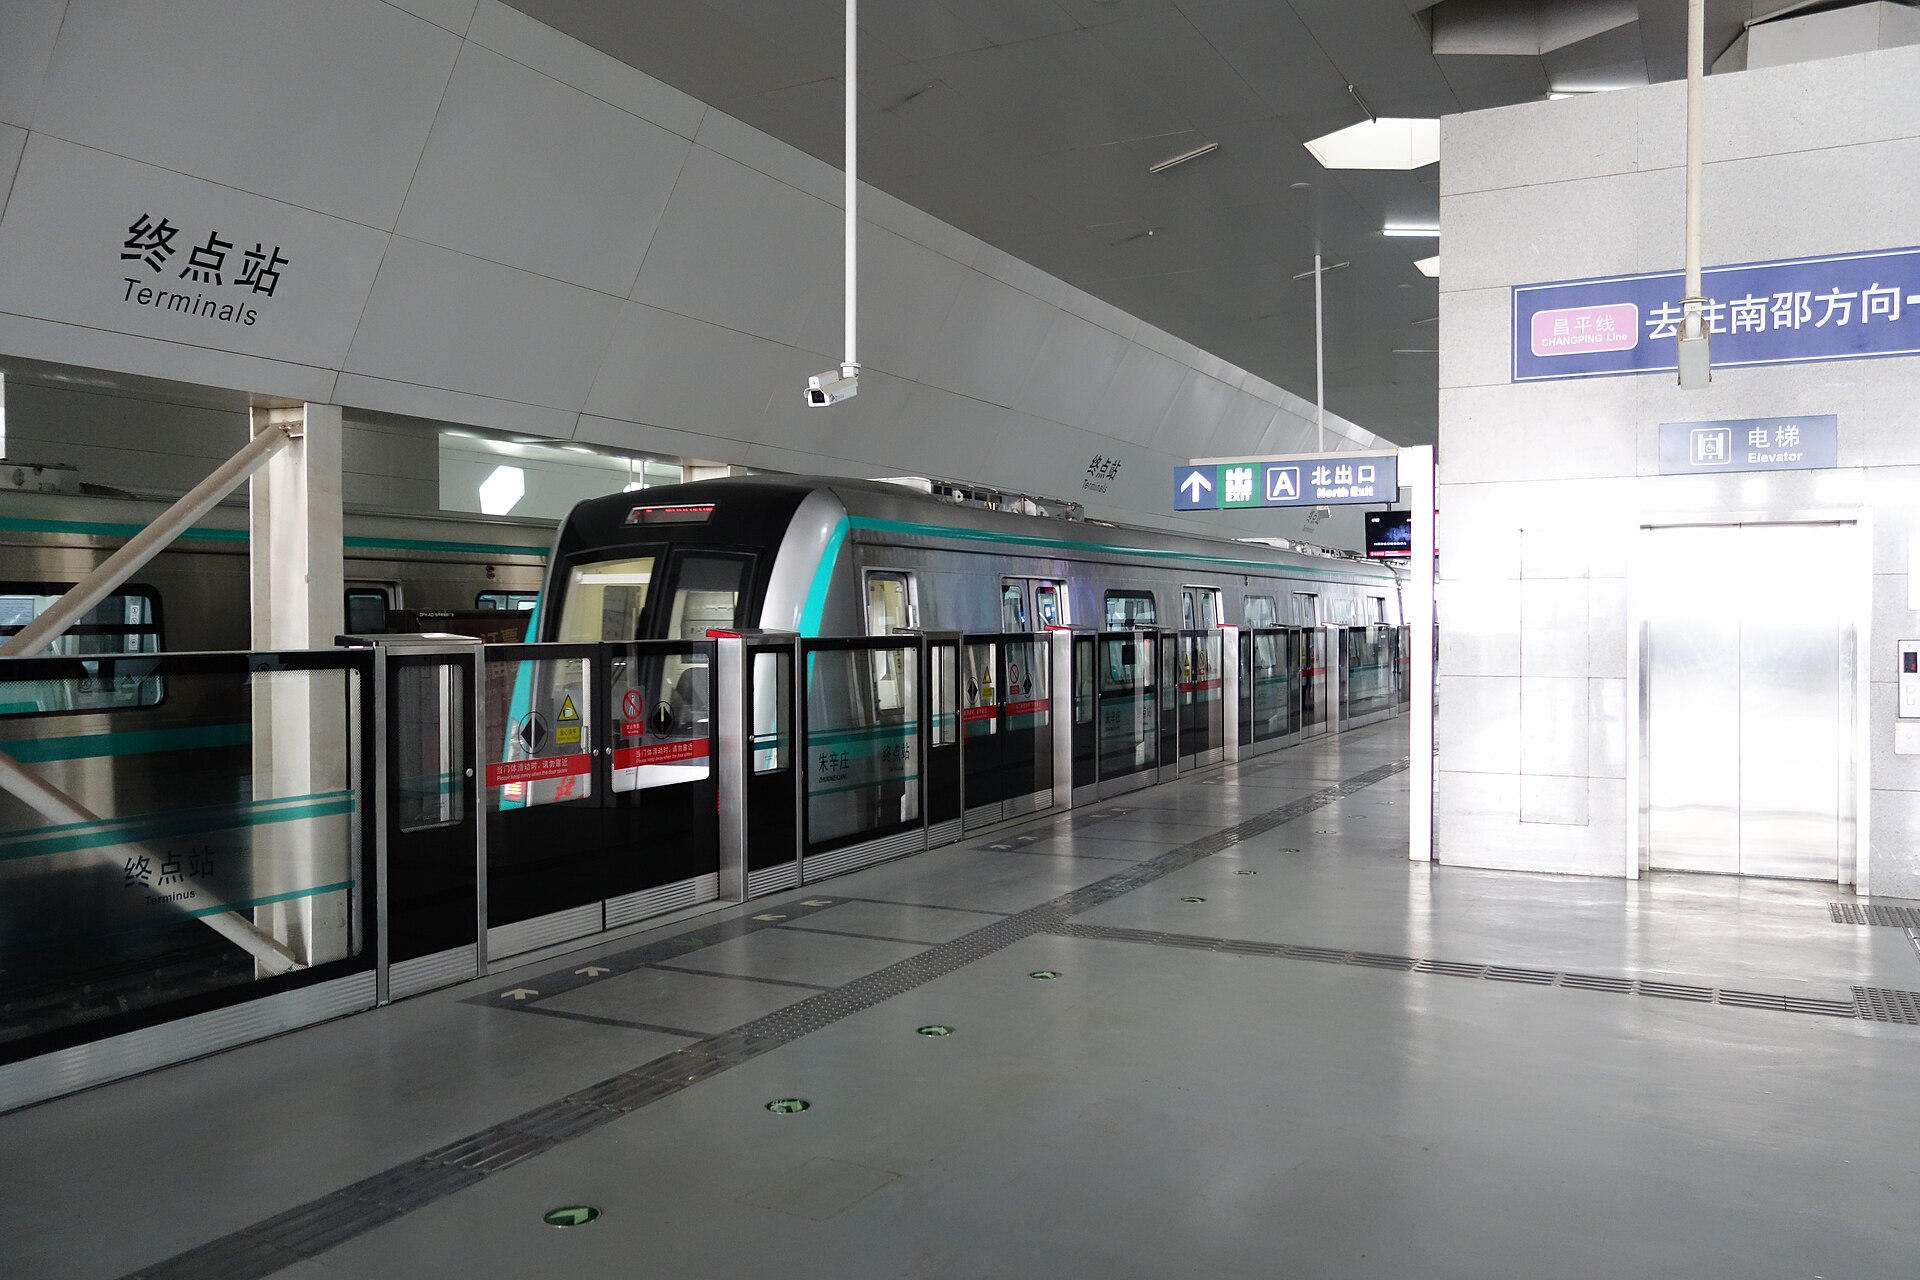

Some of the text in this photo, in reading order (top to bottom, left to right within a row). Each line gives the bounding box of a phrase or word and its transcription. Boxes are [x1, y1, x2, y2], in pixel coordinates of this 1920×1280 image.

[121, 213, 289, 297] 终点站
[123, 277, 258, 326] Terminals
[1553, 315, 1615, 336] 昌平线
[1541, 332, 1627, 347] CHANGPING Line
[1748, 425, 1800, 448] 电梯
[1087, 454, 1121, 480] 终点站
[1748, 452, 1803, 463] Elevator
[1272, 471, 1296, 497] A
[1311, 464, 1375, 486] 北出口
[1317, 485, 1373, 498] North Exit
[819, 750, 850, 773] 朱辛庄
[882, 742, 910, 762] 终点站
[124, 847, 215, 889] 终点站
[145, 889, 196, 906] Terminus
